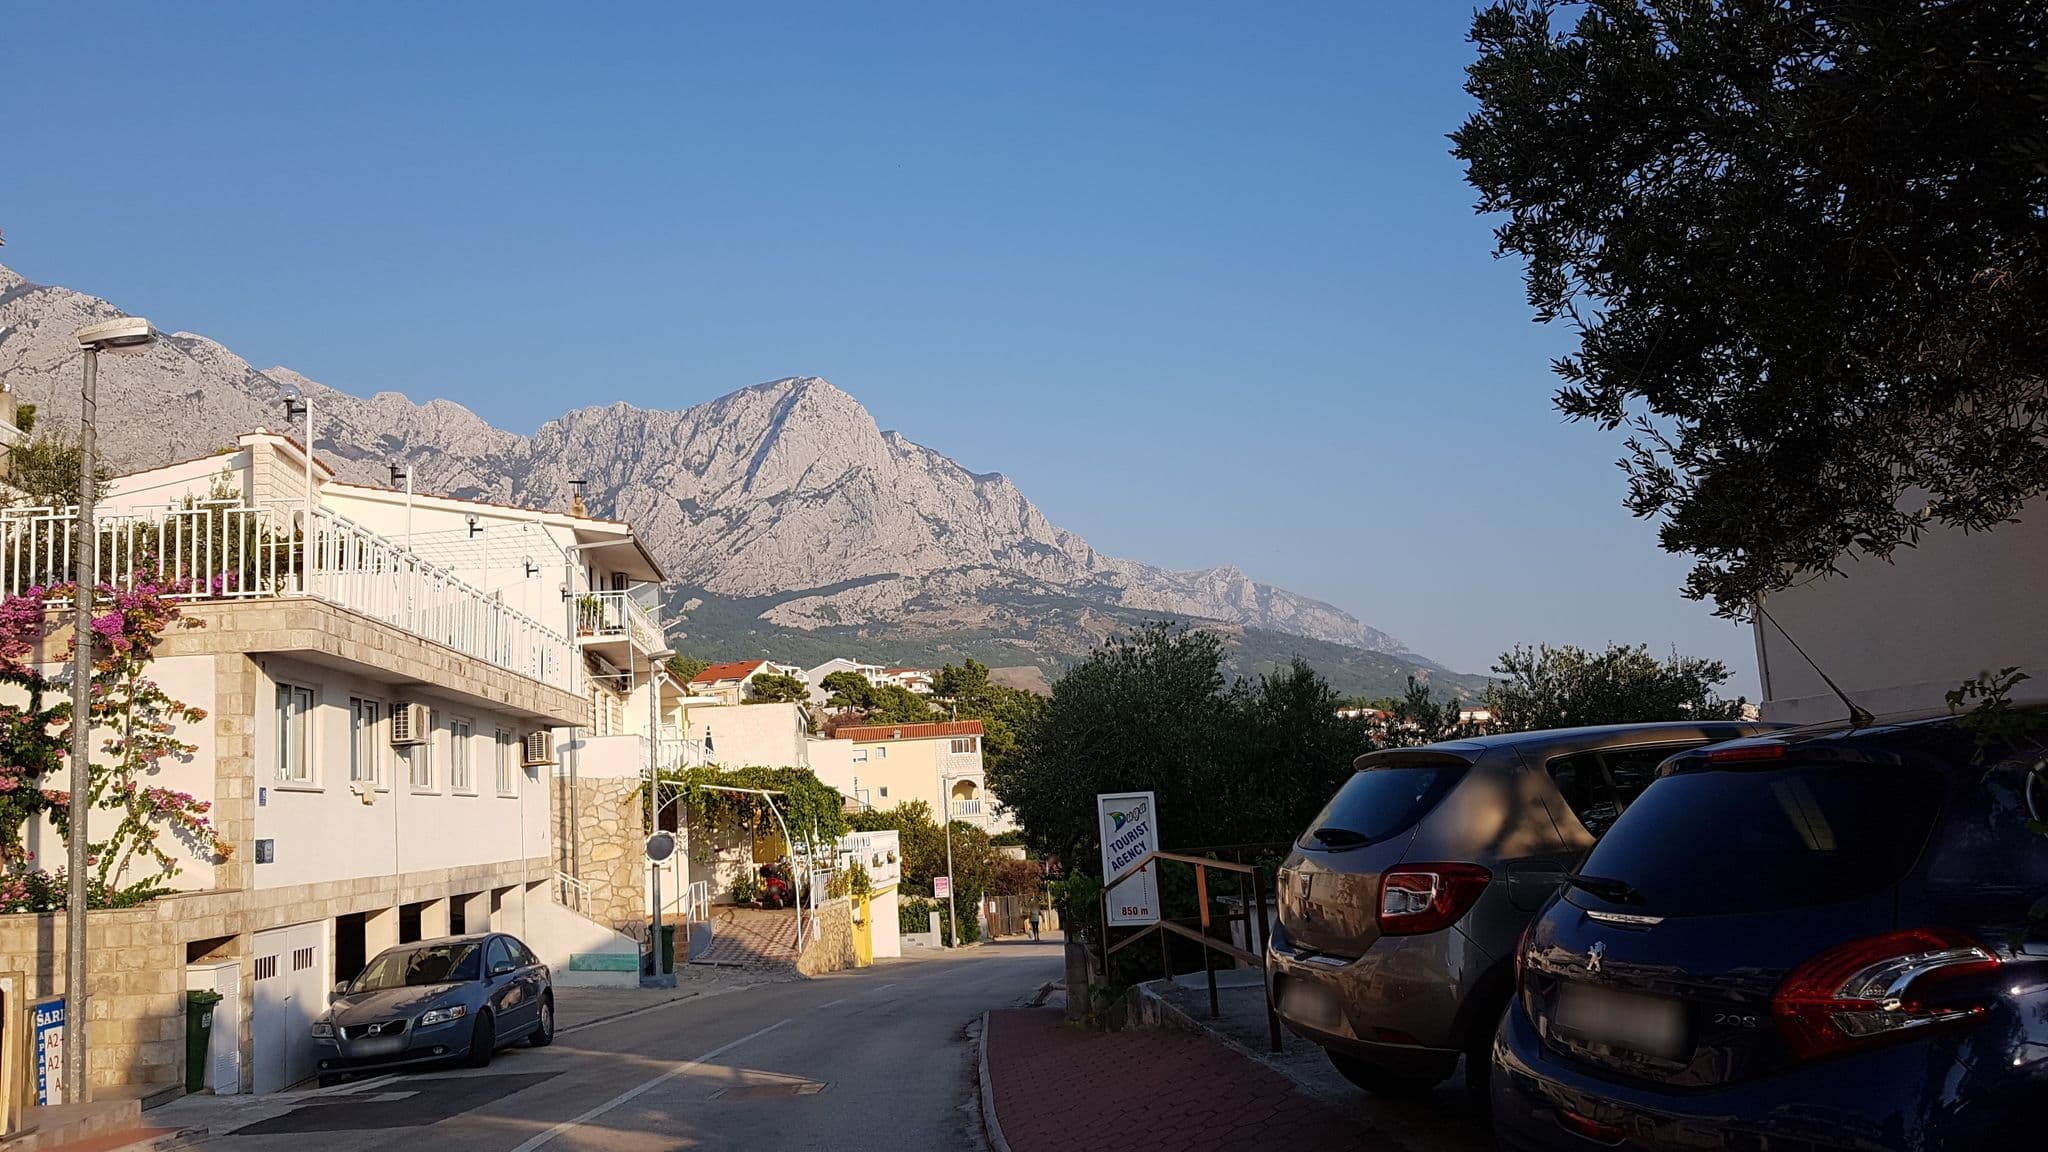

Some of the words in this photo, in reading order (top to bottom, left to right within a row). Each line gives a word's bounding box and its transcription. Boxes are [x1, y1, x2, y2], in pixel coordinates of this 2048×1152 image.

[1109, 821, 1149, 854] TOURIST
[1111, 840, 1147, 872] AGENCY
[1121, 906, 1138, 916] 850
[1140, 907, 1149, 916] m
